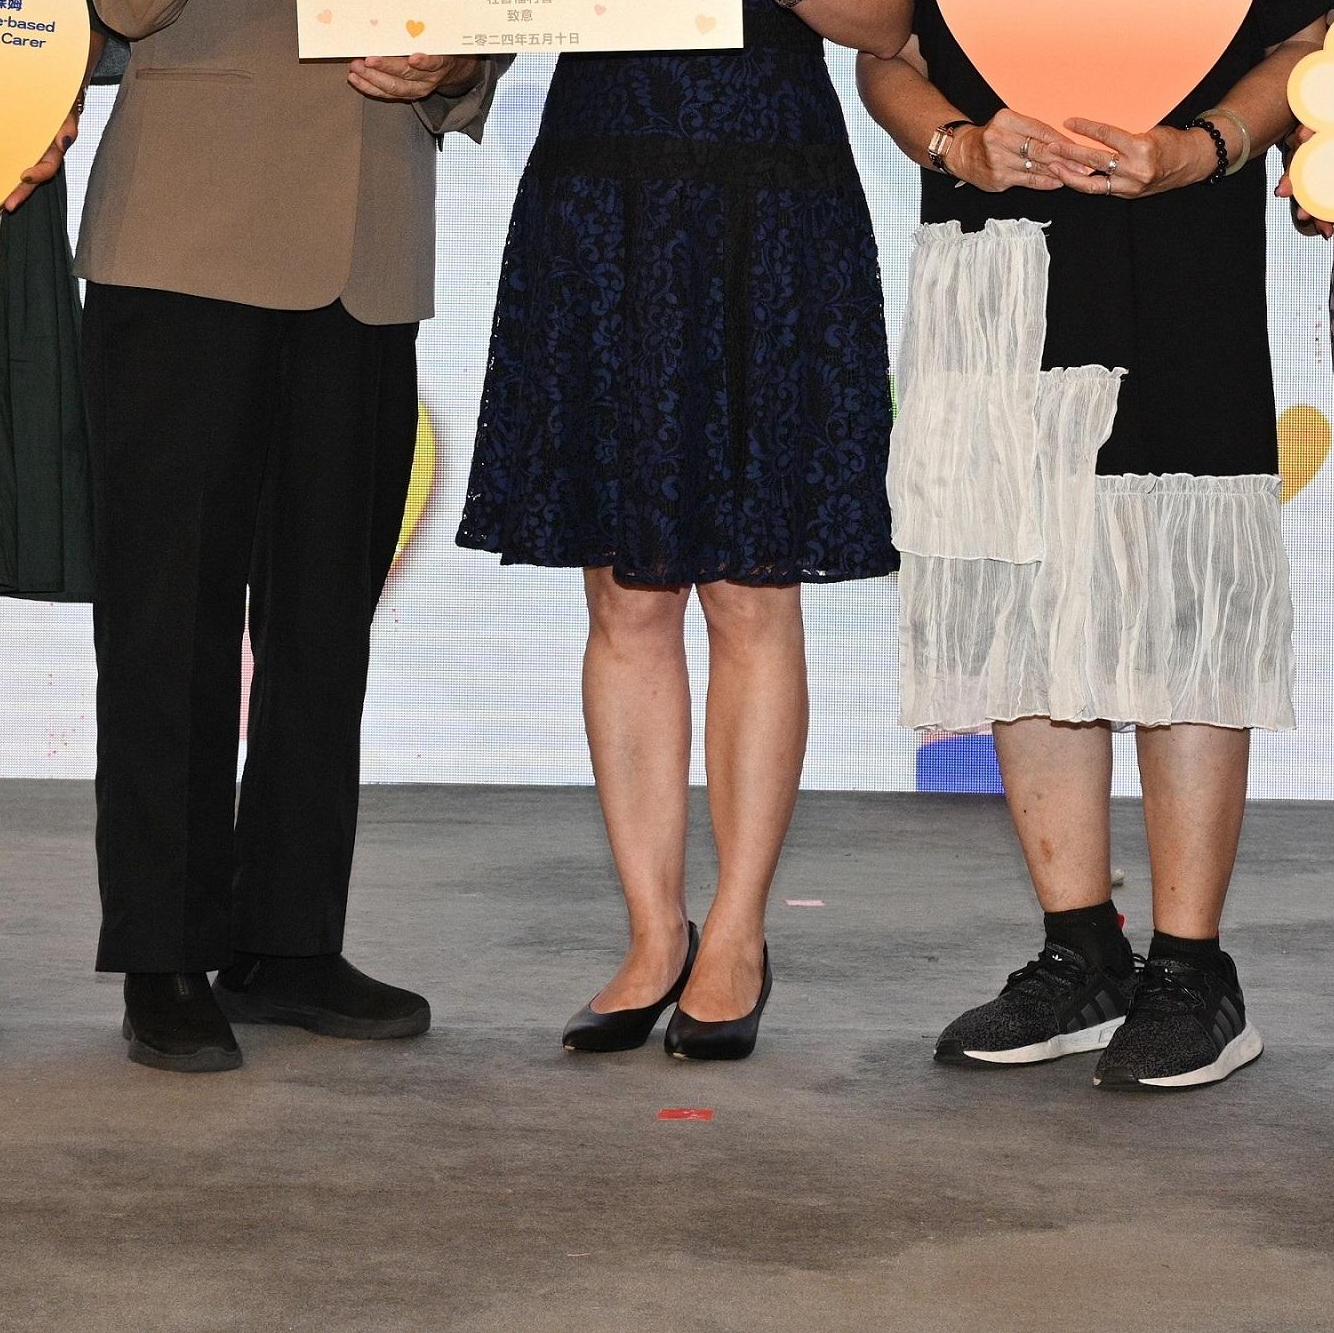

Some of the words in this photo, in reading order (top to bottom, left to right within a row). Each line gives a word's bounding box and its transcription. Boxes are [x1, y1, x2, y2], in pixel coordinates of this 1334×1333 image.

[507, 9, 533, 23] 致意
[1, 32, 47, 48] Carer
[461, 32, 580, 47] 二零二四年五月十日
